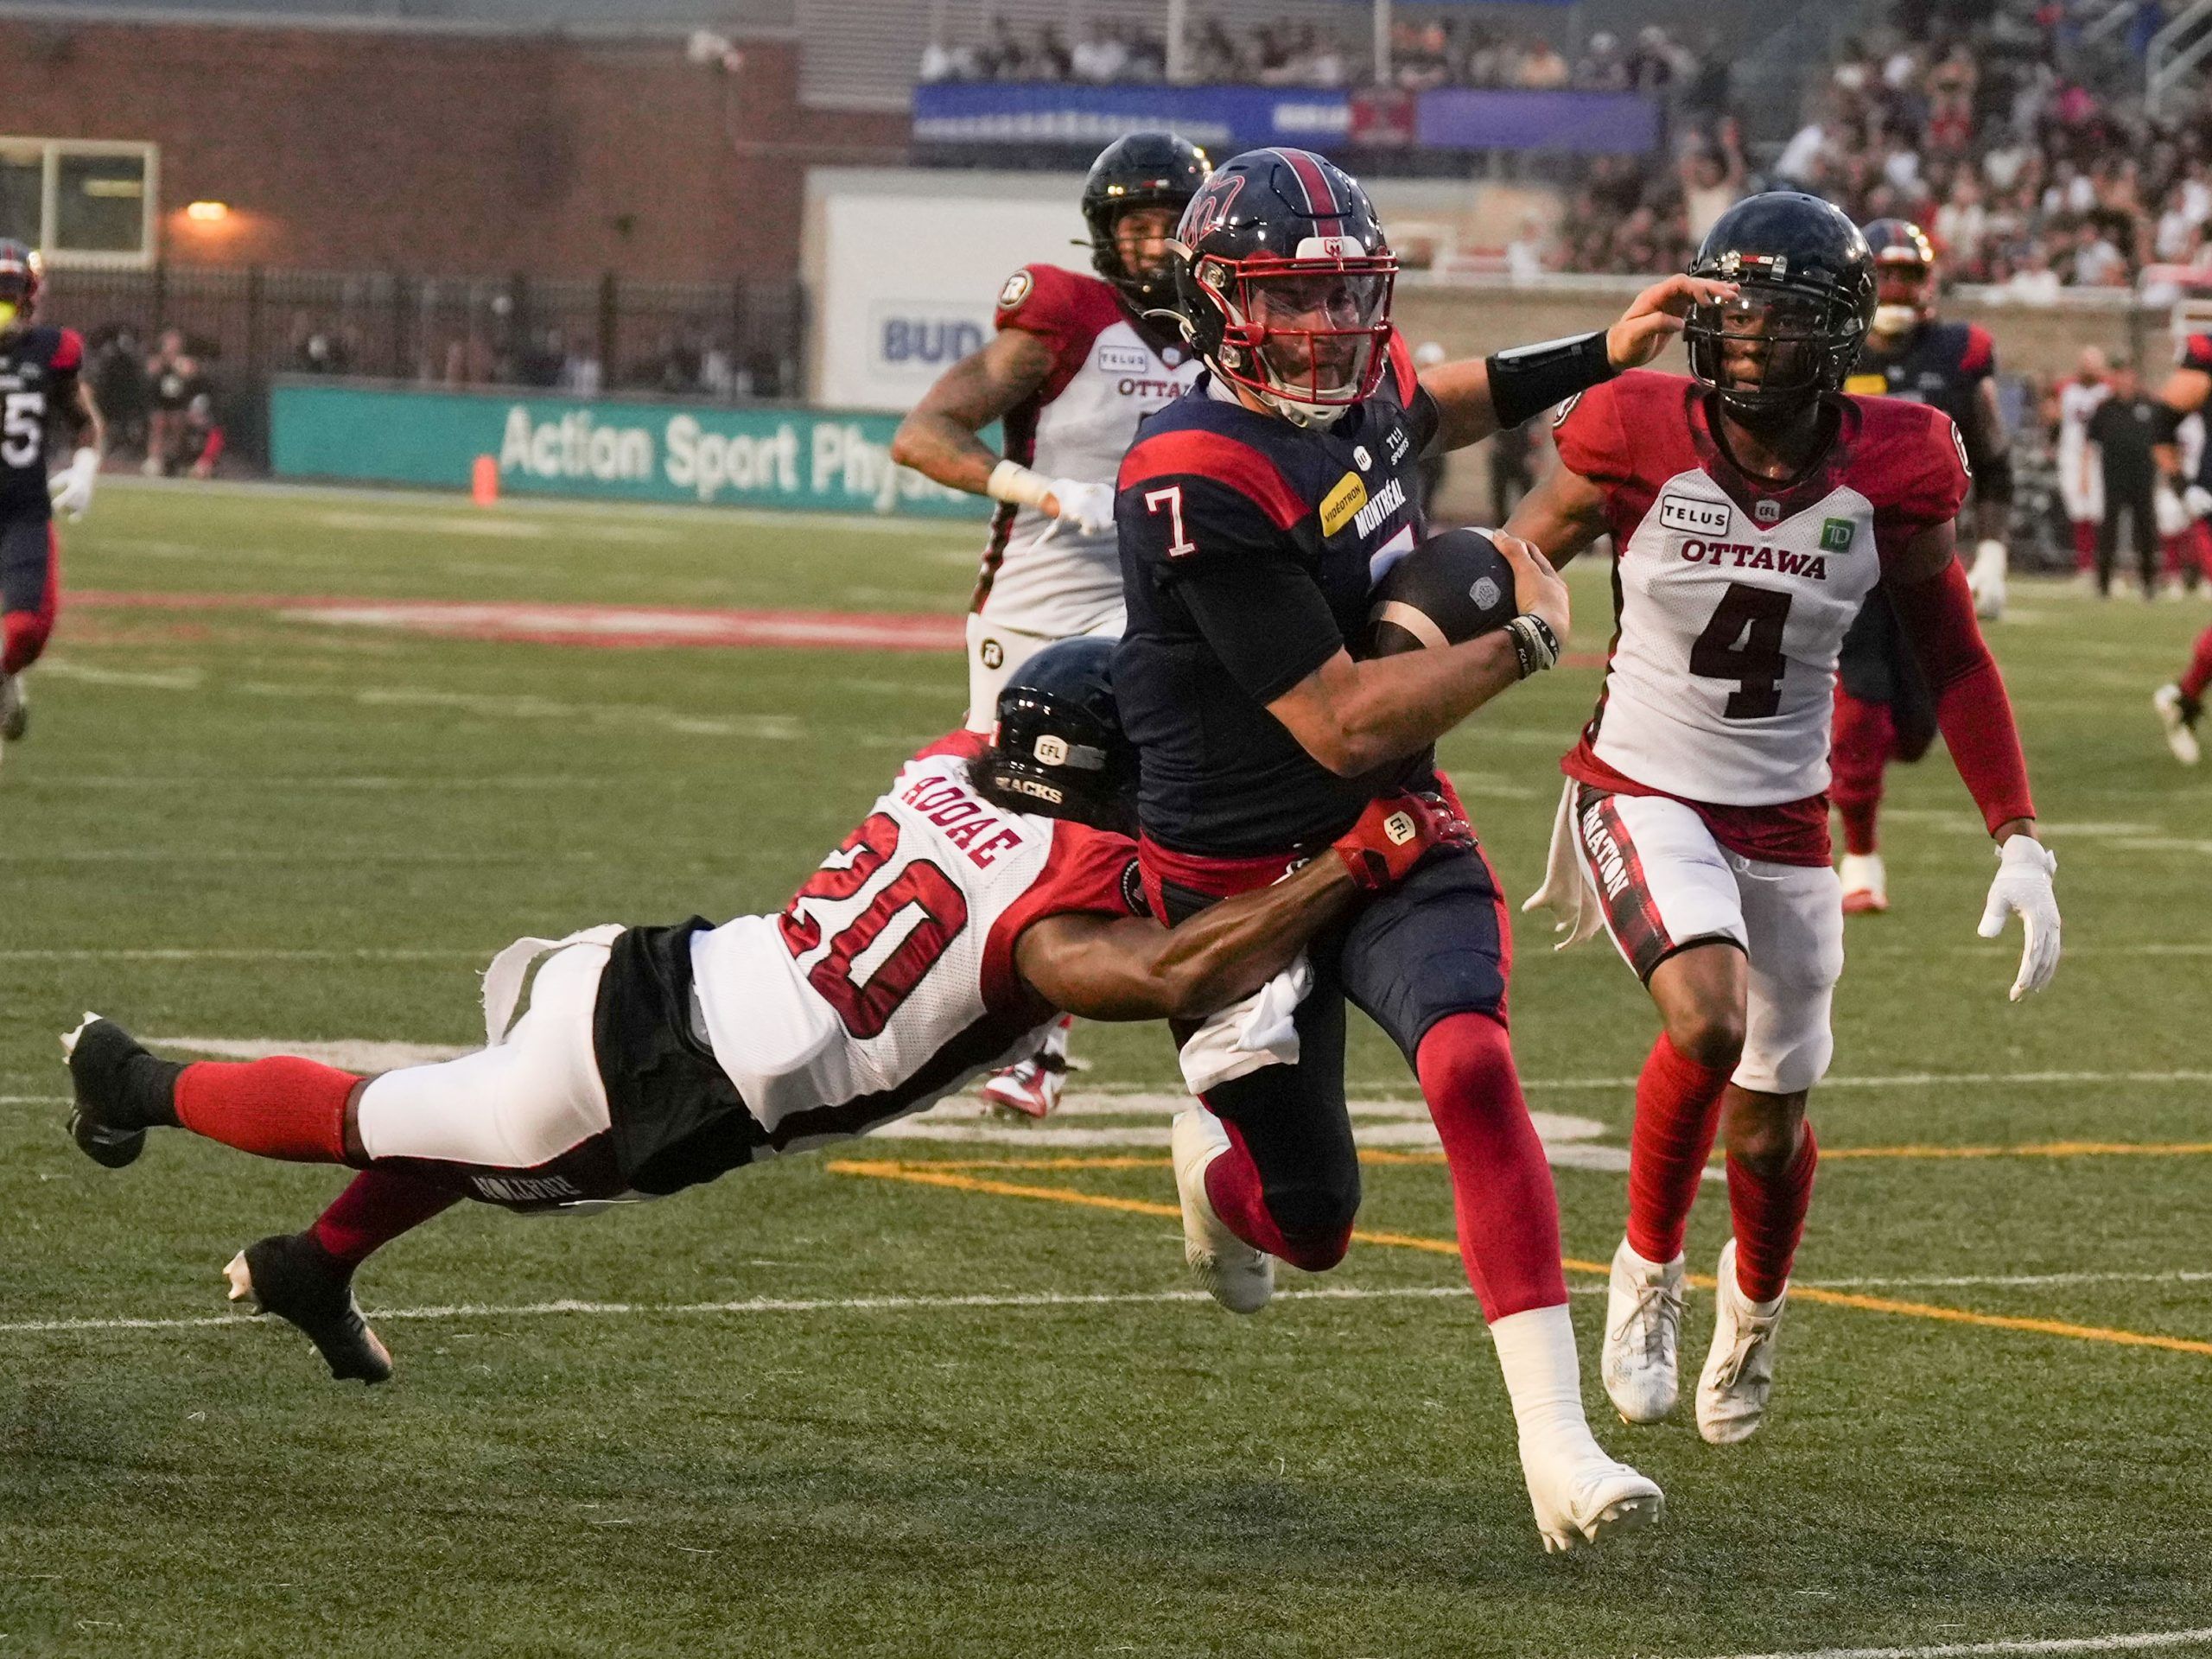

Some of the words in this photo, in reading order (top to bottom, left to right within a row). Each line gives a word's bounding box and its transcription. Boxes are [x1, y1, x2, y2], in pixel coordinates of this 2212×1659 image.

[1100, 353, 1145, 365] TELUS
[1118, 378, 1192, 397] OTTA
[503, 405, 654, 480] Action
[664, 413, 798, 502] Sport
[1354, 478, 1407, 540] MONTRÉAL
[1665, 505, 1726, 527] TELUS
[1758, 505, 1777, 517] CFL
[1144, 485, 1198, 558] 7
[1827, 524, 1850, 545] TD
[1681, 539, 1827, 581] OTTAWA
[1689, 582, 1793, 719] 4
[1039, 744, 1061, 760] CFL
[901, 776, 1024, 870] ADDAE
[1389, 817, 1406, 841] CFL
